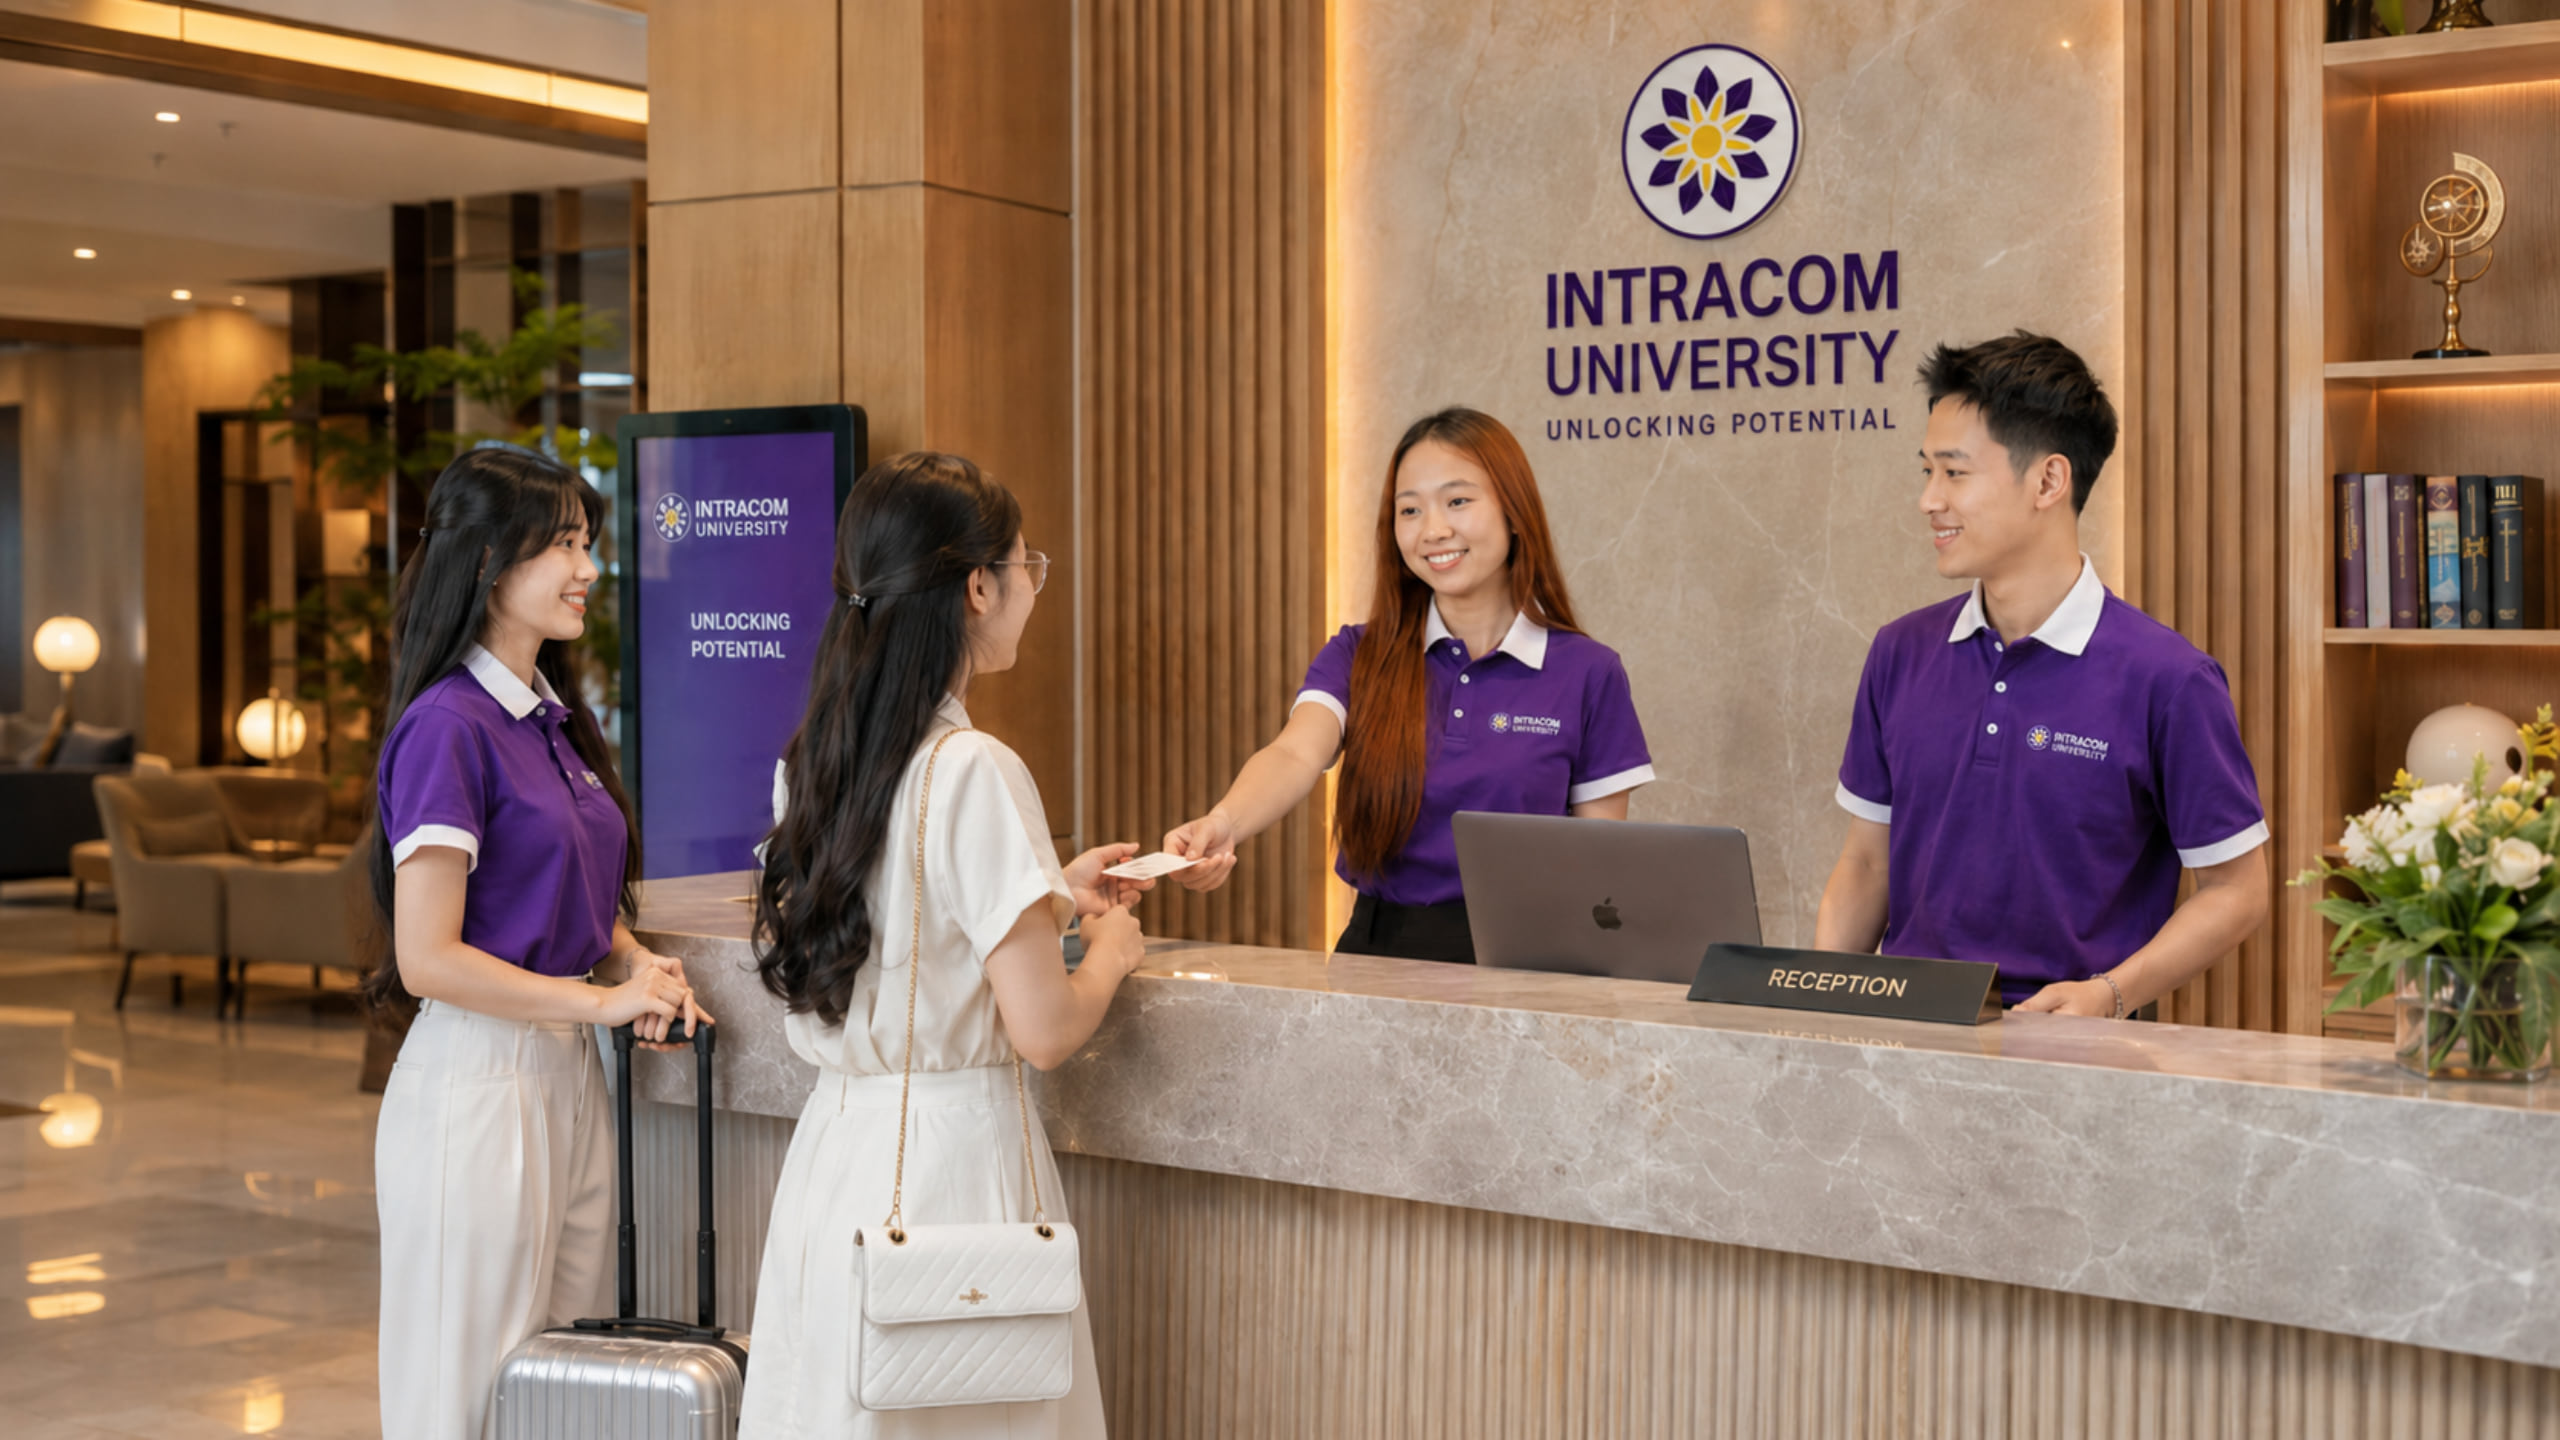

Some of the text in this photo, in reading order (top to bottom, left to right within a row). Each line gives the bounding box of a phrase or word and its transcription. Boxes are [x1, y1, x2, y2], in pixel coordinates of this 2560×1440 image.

[1546, 250, 1900, 329] INTRACOM
[1546, 330, 1900, 396] UNIVERSITY
[1546, 408, 1897, 441] UNLOCKING POTENTIAL
[695, 498, 789, 518] INTRACOM
[695, 520, 789, 537] UNIVERSITY
[690, 612, 791, 631] UNLOCKING
[691, 640, 786, 659] POTENTIAL
[1767, 968, 1908, 998] RECEPTION
